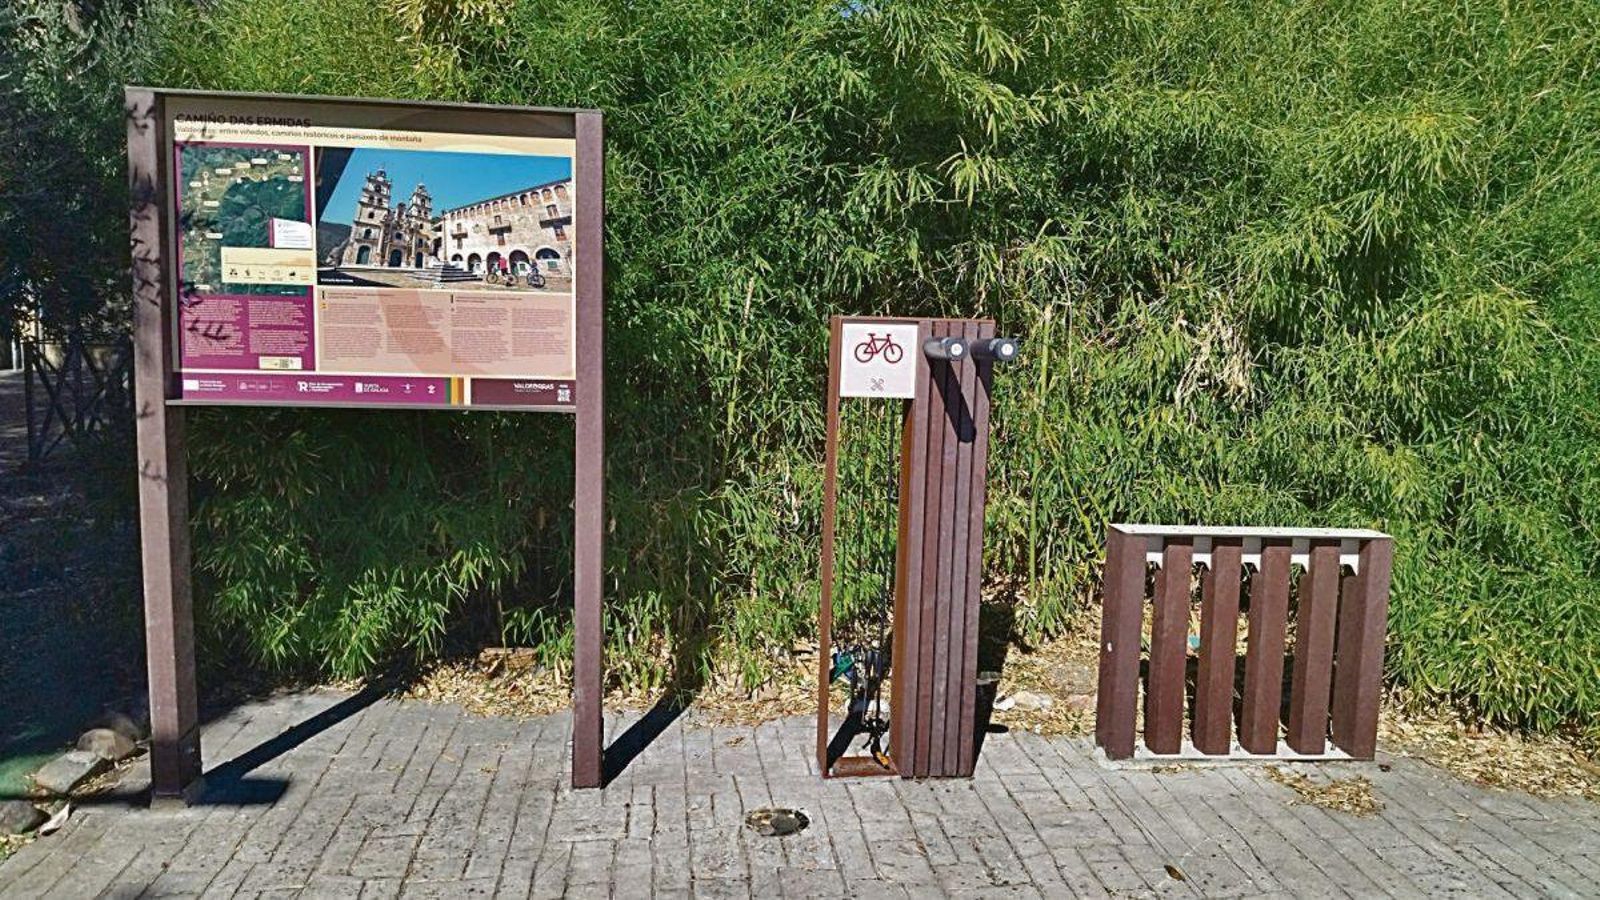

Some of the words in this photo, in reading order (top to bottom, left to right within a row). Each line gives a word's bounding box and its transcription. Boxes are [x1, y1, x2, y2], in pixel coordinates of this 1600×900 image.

[175, 112, 226, 123] CAMIÑO
[229, 114, 252, 124] DAS
[256, 115, 311, 127] ERMIDAS
[219, 127, 239, 135] entre
